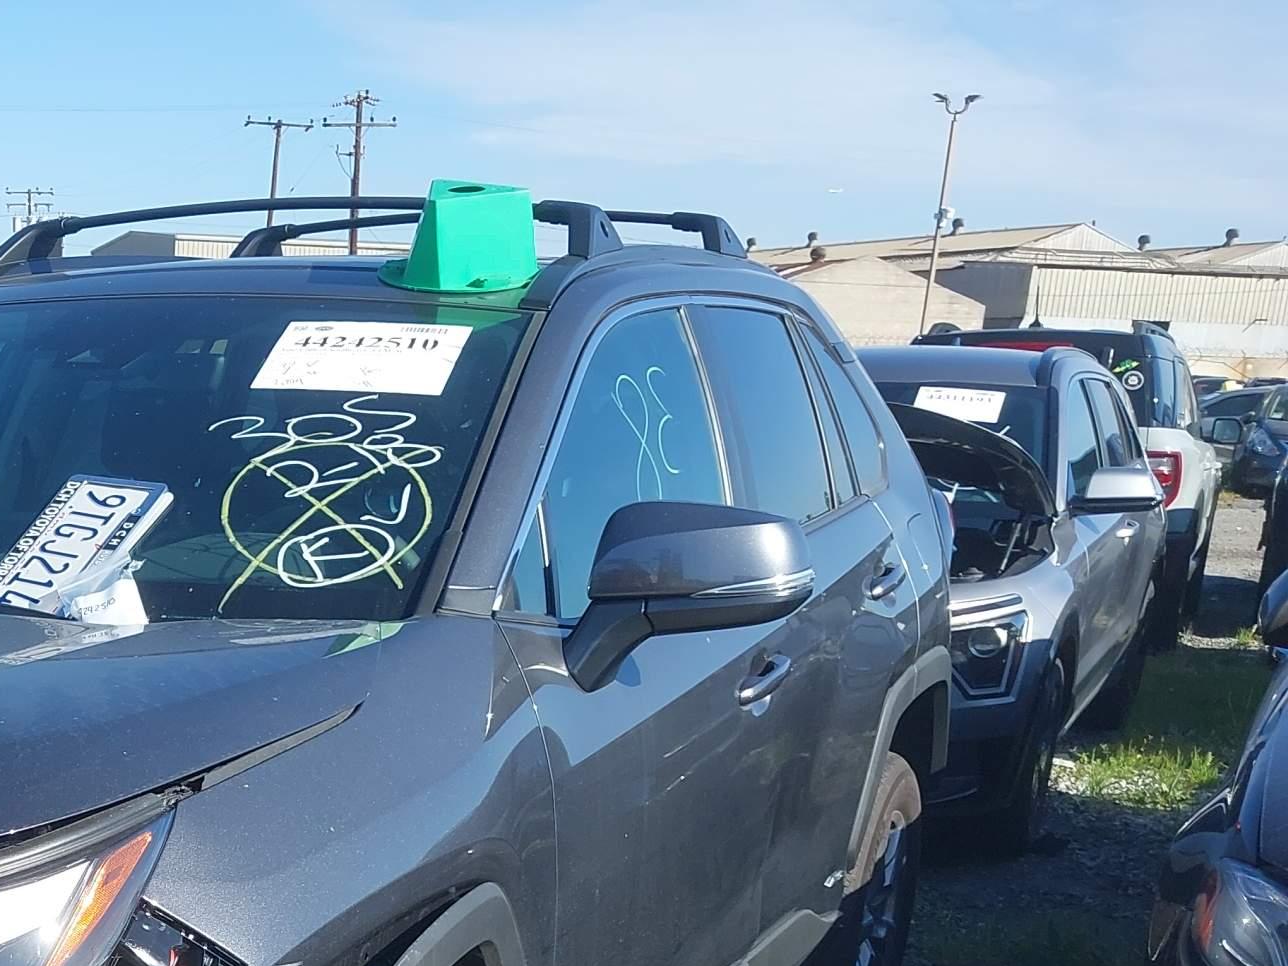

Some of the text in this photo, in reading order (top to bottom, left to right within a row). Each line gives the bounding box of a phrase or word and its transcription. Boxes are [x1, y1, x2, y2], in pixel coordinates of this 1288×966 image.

[294, 336, 440, 350] 44242510
[53, 481, 81, 501] DCH
[24, 501, 65, 537] TOYOTA
[107, 521, 134, 546] DCH
[12, 537, 35, 551] OF
